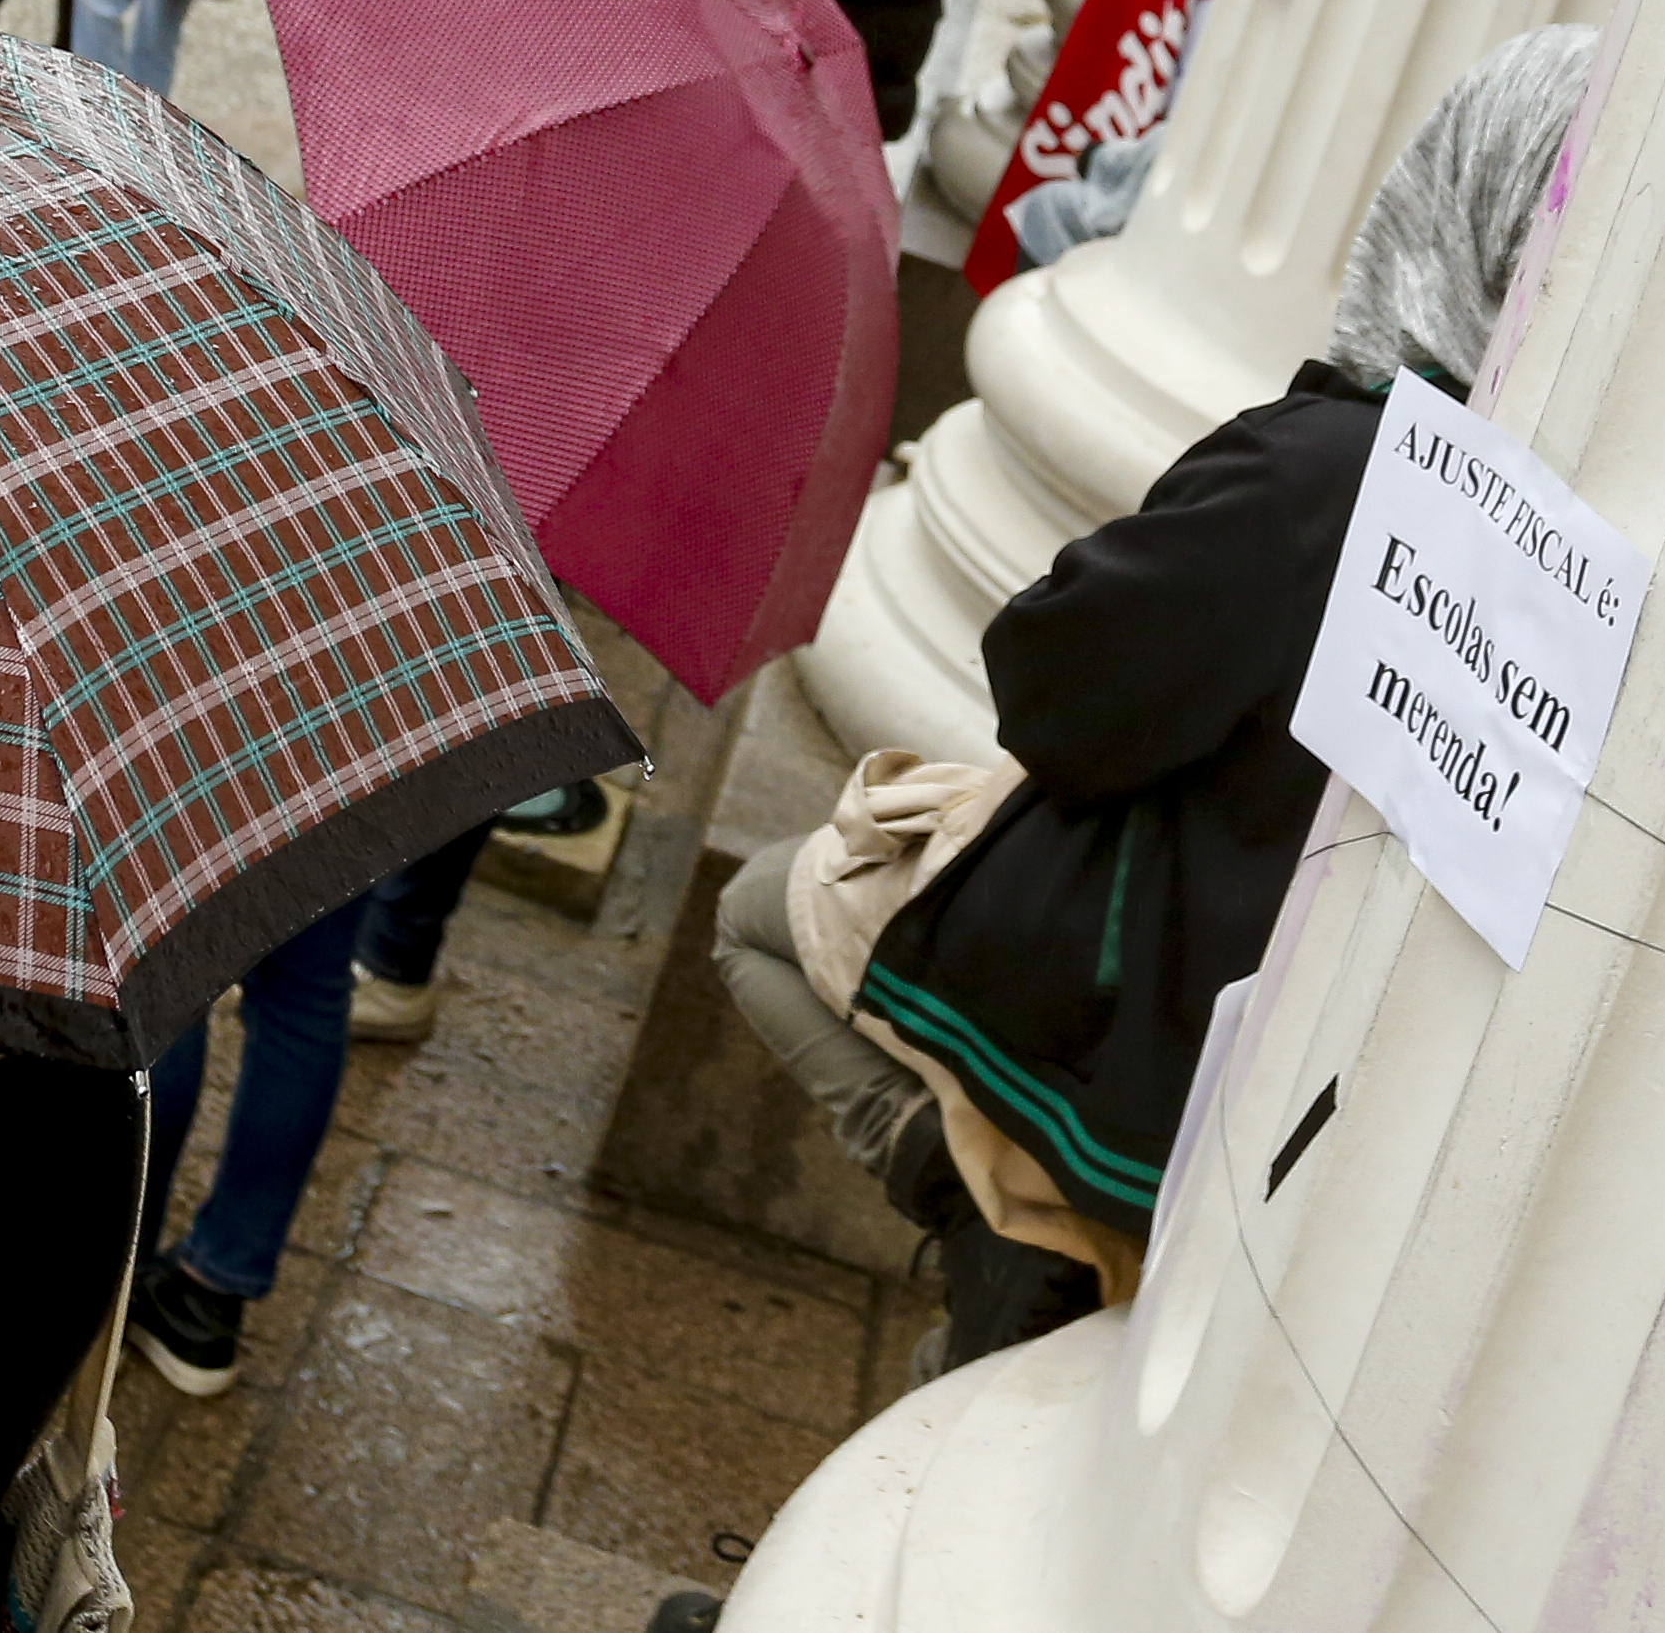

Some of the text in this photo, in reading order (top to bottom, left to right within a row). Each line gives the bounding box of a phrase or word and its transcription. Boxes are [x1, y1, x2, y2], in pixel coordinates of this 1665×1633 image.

[1392, 421, 1622, 628] AJUSTE FISCAL é:
[1364, 657, 1522, 834] merenda!
[1370, 532, 1572, 755] Escolas sem
